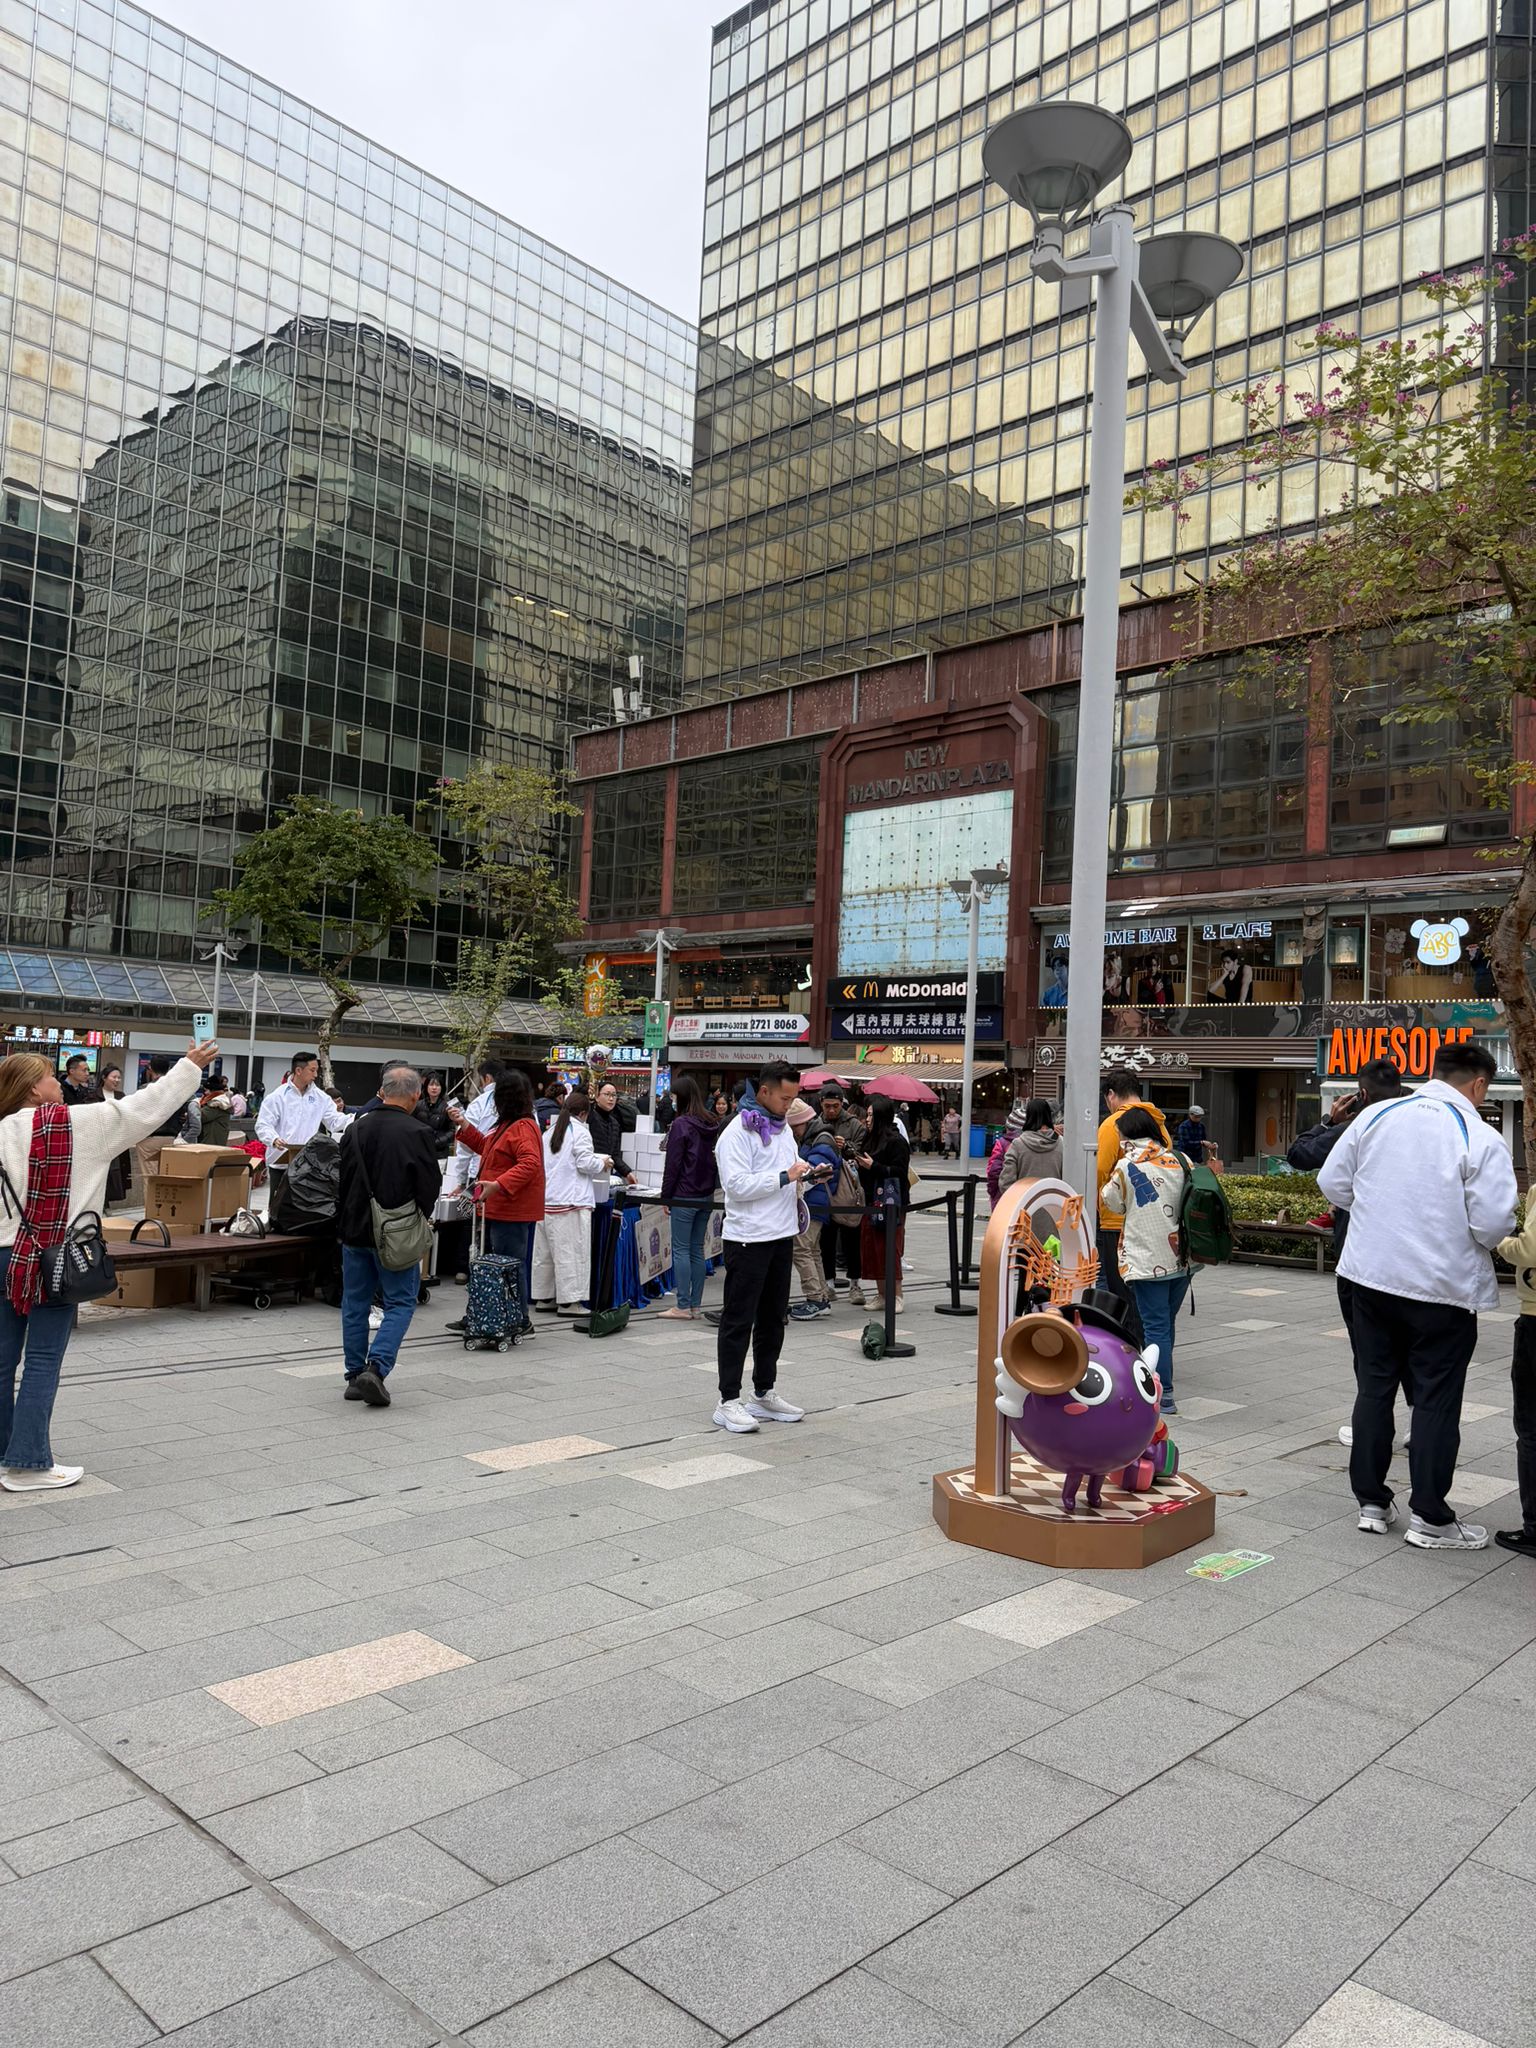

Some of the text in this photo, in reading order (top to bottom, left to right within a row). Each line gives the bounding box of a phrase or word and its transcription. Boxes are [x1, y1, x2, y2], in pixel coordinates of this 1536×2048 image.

[904, 743, 950, 771] NEW
[848, 759, 1014, 804] MANDARIN PLAZA
[1139, 927, 1177, 944] BAR
[1203, 924, 1217, 940] &
[1220, 921, 1272, 940] CAFE
[1421, 931, 1458, 960] ABC
[885, 981, 978, 998] McDonald
[750, 1019, 771, 1030] 2721
[774, 1019, 798, 1030] 8068
[901, 1027, 941, 1035] SIMULATOR
[942, 1027, 966, 1035] CENTE
